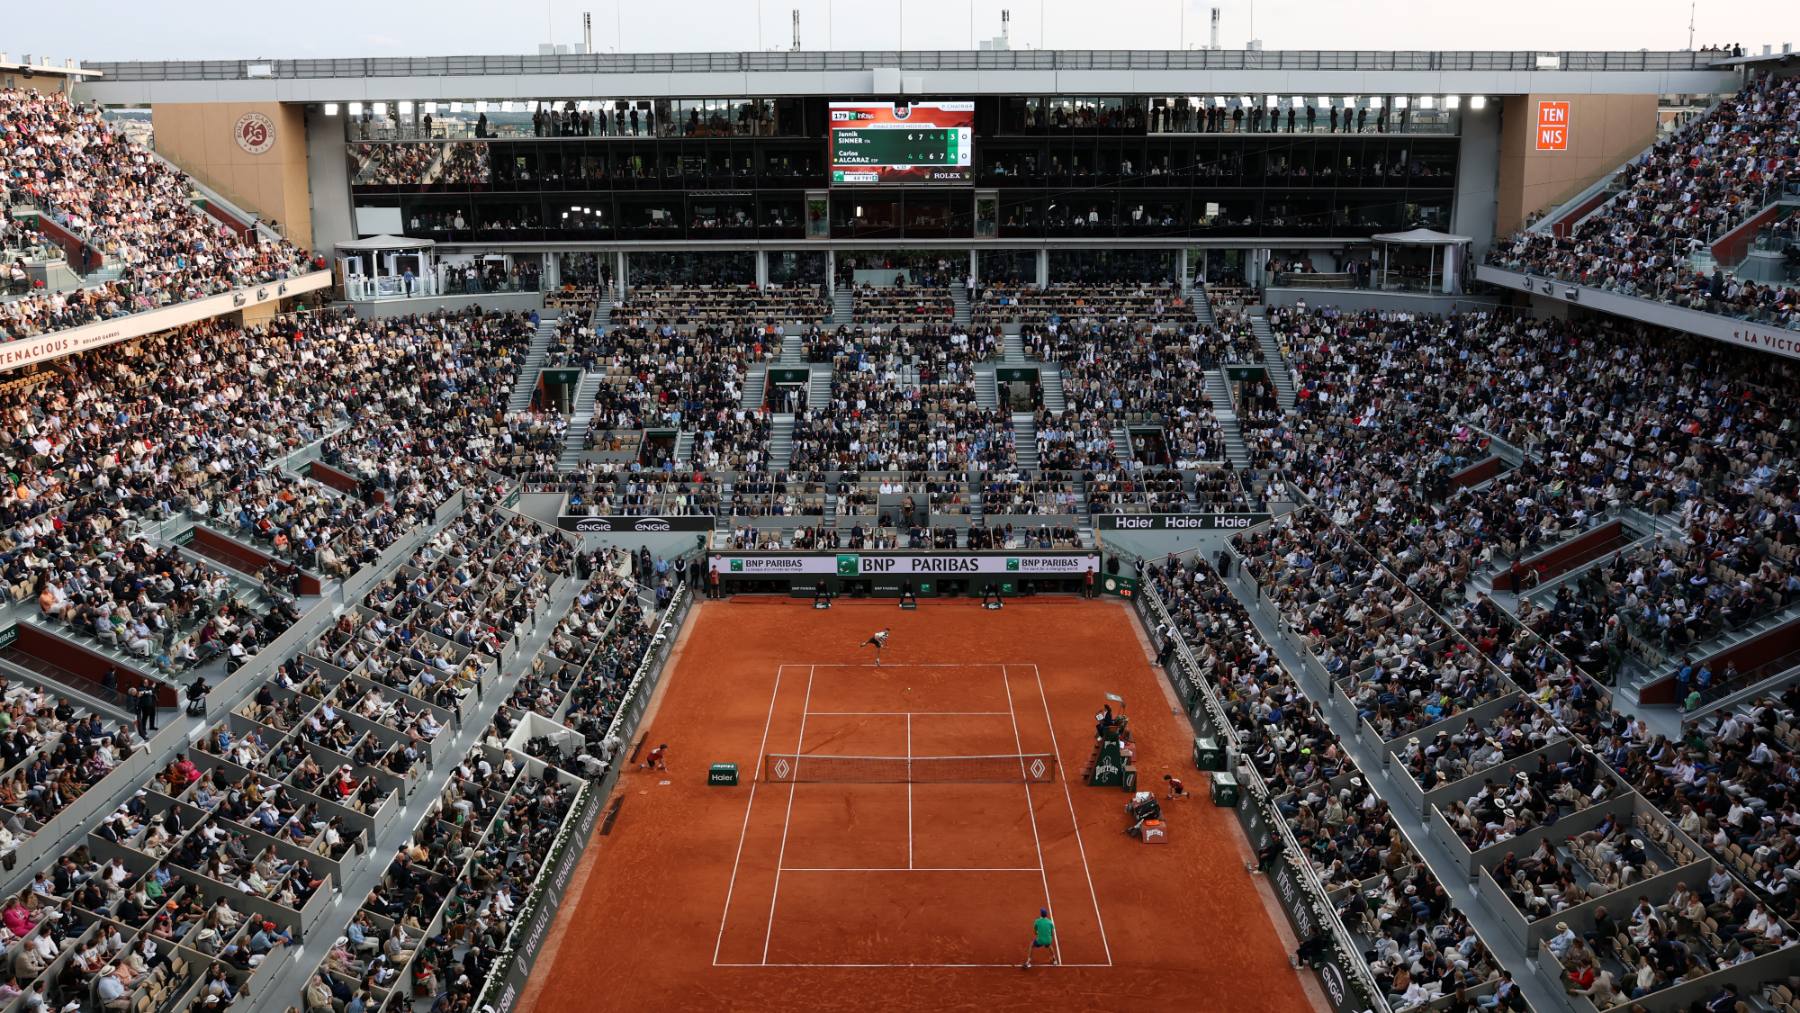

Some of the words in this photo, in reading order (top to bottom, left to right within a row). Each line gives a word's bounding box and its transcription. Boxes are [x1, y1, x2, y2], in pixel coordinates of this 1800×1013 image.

[1543, 108, 1564, 122] TEN
[1542, 130, 1562, 144] NIS
[1745, 331, 1757, 344] LA
[1764, 335, 1800, 353] VICTO
[0, 339, 69, 365] TENACIOUS
[1116, 517, 1154, 528] Haier
[1165, 516, 1203, 528] Haier
[1214, 516, 1252, 528] Haier
[745, 559, 764, 567] BNP
[766, 559, 803, 567] PARIBAS
[862, 558, 896, 571] BNP
[911, 558, 979, 571] PARIBAS
[1021, 558, 1040, 566] BNP
[1042, 558, 1079, 566] PARIBAS
[581, 798, 600, 834] RENAULT
[555, 847, 576, 891] RENAULT
[525, 906, 550, 958] RENAULT
